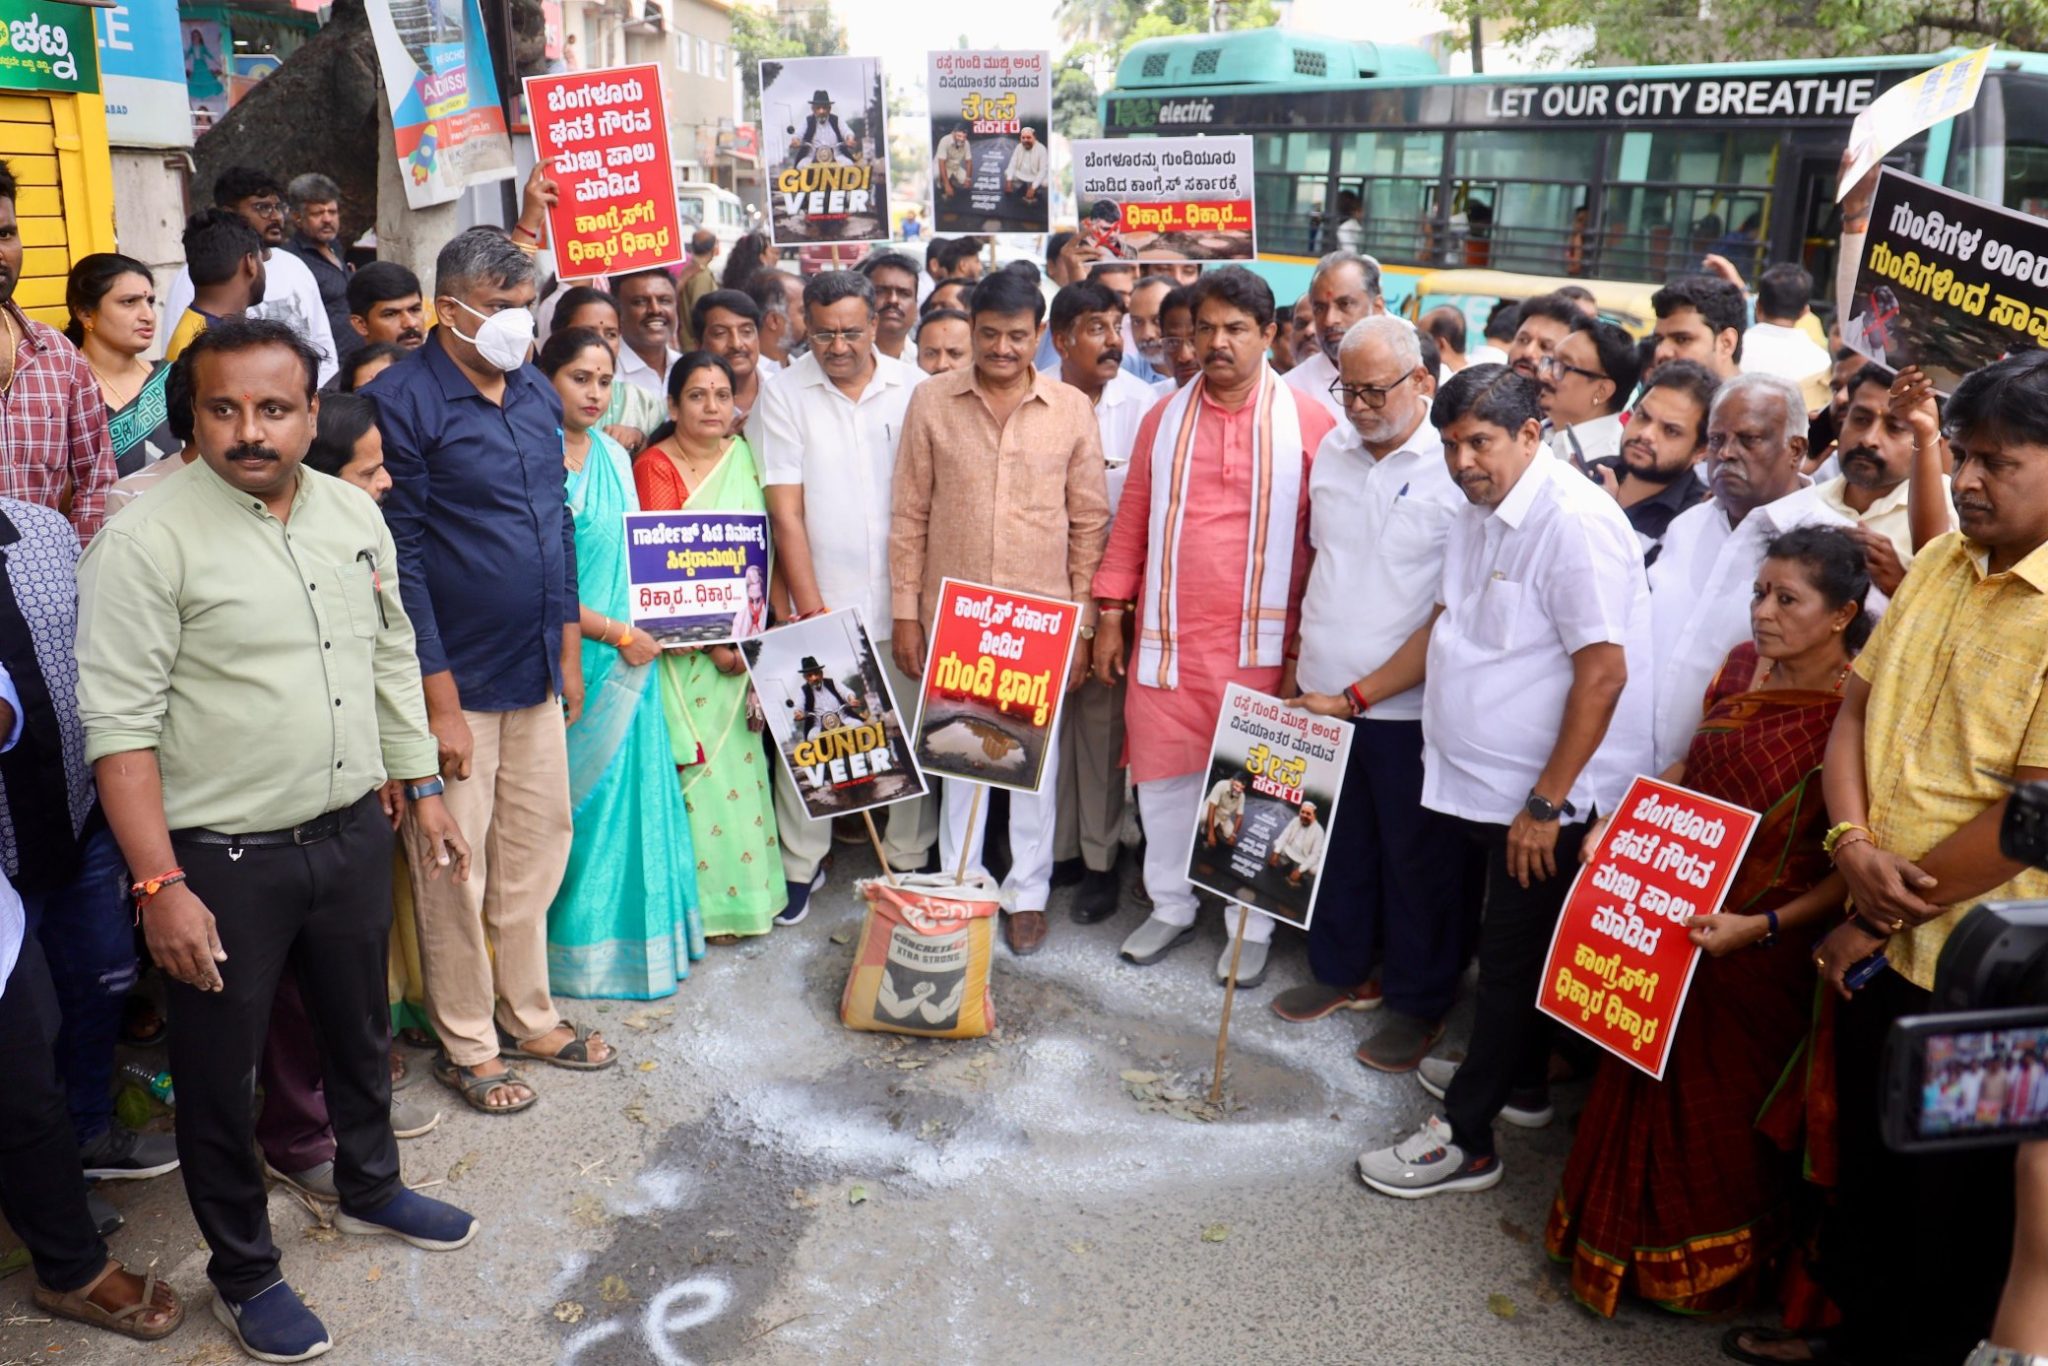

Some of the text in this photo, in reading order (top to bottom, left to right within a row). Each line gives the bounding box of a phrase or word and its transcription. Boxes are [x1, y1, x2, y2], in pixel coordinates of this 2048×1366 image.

[9, 12, 78, 81] ಚಟ್ನಿ
[936, 54, 1042, 75] ರಸ್ತೆ ಗುಂಡಿ ಮುಚ್ಚಿ ಅಂದ್ರೆ
[547, 78, 644, 111] ಬೆಂಗಳೂರು
[938, 75, 1040, 89] ವಿಷಯಾಂತರ ಮಾಡುವ
[1485, 87, 1539, 118] LET
[1541, 84, 1608, 117] OUR
[1616, 81, 1691, 116] CITY
[1695, 78, 1875, 115] BREATHE
[961, 91, 1017, 121] ತೇಪೆ
[973, 118, 1021, 134] ಸರ್ಕಾರ
[1159, 96, 1215, 124] electric
[548, 107, 651, 148] ಘನತೆ ಗೌರವ
[554, 142, 656, 177] ಮಣ್ಣು ಪಾಲು
[778, 165, 873, 193] GUNDI
[1085, 149, 1236, 173] ಬೆಂಗಳೂರನ್ನು ಗುಂಡಿಯೂರು
[575, 170, 641, 202] ಮಾಡಿದ
[783, 190, 870, 216] VEER
[1085, 174, 1241, 197] ಮಾಡಿದ ಕಾಂಗ್ರೆಸ್ ಸರ್ಕಾರಕ್ಕೆ
[567, 226, 670, 267] ಧಿಕ್ಕಾರ ಧಿಕ್ಕಾರ
[1888, 200, 1983, 262] ಗುಂಡಿಗಳ
[1868, 240, 1991, 317] ಗುಂಡಿಗಳಿಂದ
[954, 594, 1063, 636] ಕಾಂಗ್ರೆಸ್ ಸರ್ಕಾರ
[978, 630, 1025, 661] ನೀಡಿದ
[934, 650, 1051, 727] ಗುಂಡಿ ಭಾಗ್ಯ
[1230, 715, 1336, 763] ವಿಷಯಾಂತರ ಮಾಡುವ
[1233, 695, 1342, 747] ರಸ್ತೆ ಗುಂಡಿ ಮುಚ್ಚಿ ಅಂದ್ರೆ
[793, 721, 888, 768] GUNDI
[803, 747, 892, 789] VEER
[1245, 743, 1308, 789] ತೇಪೆ
[1252, 775, 1305, 805] ಸರ್ಕಾರ
[1632, 793, 1727, 849] ಬೆಂಗಳೂರು
[1609, 827, 1716, 890] ಘನತೆ ಗೌರವ
[1591, 862, 1696, 927] ಮಣ್ಣು ಪಾಲು
[1590, 904, 1662, 957] ಮಾಡಿದ
[896, 945, 961, 964] XTRA STRONG
[1555, 966, 1659, 1051] ಧಿಕ್ಕಾರ ಧಿಕ್ಕಾರ
